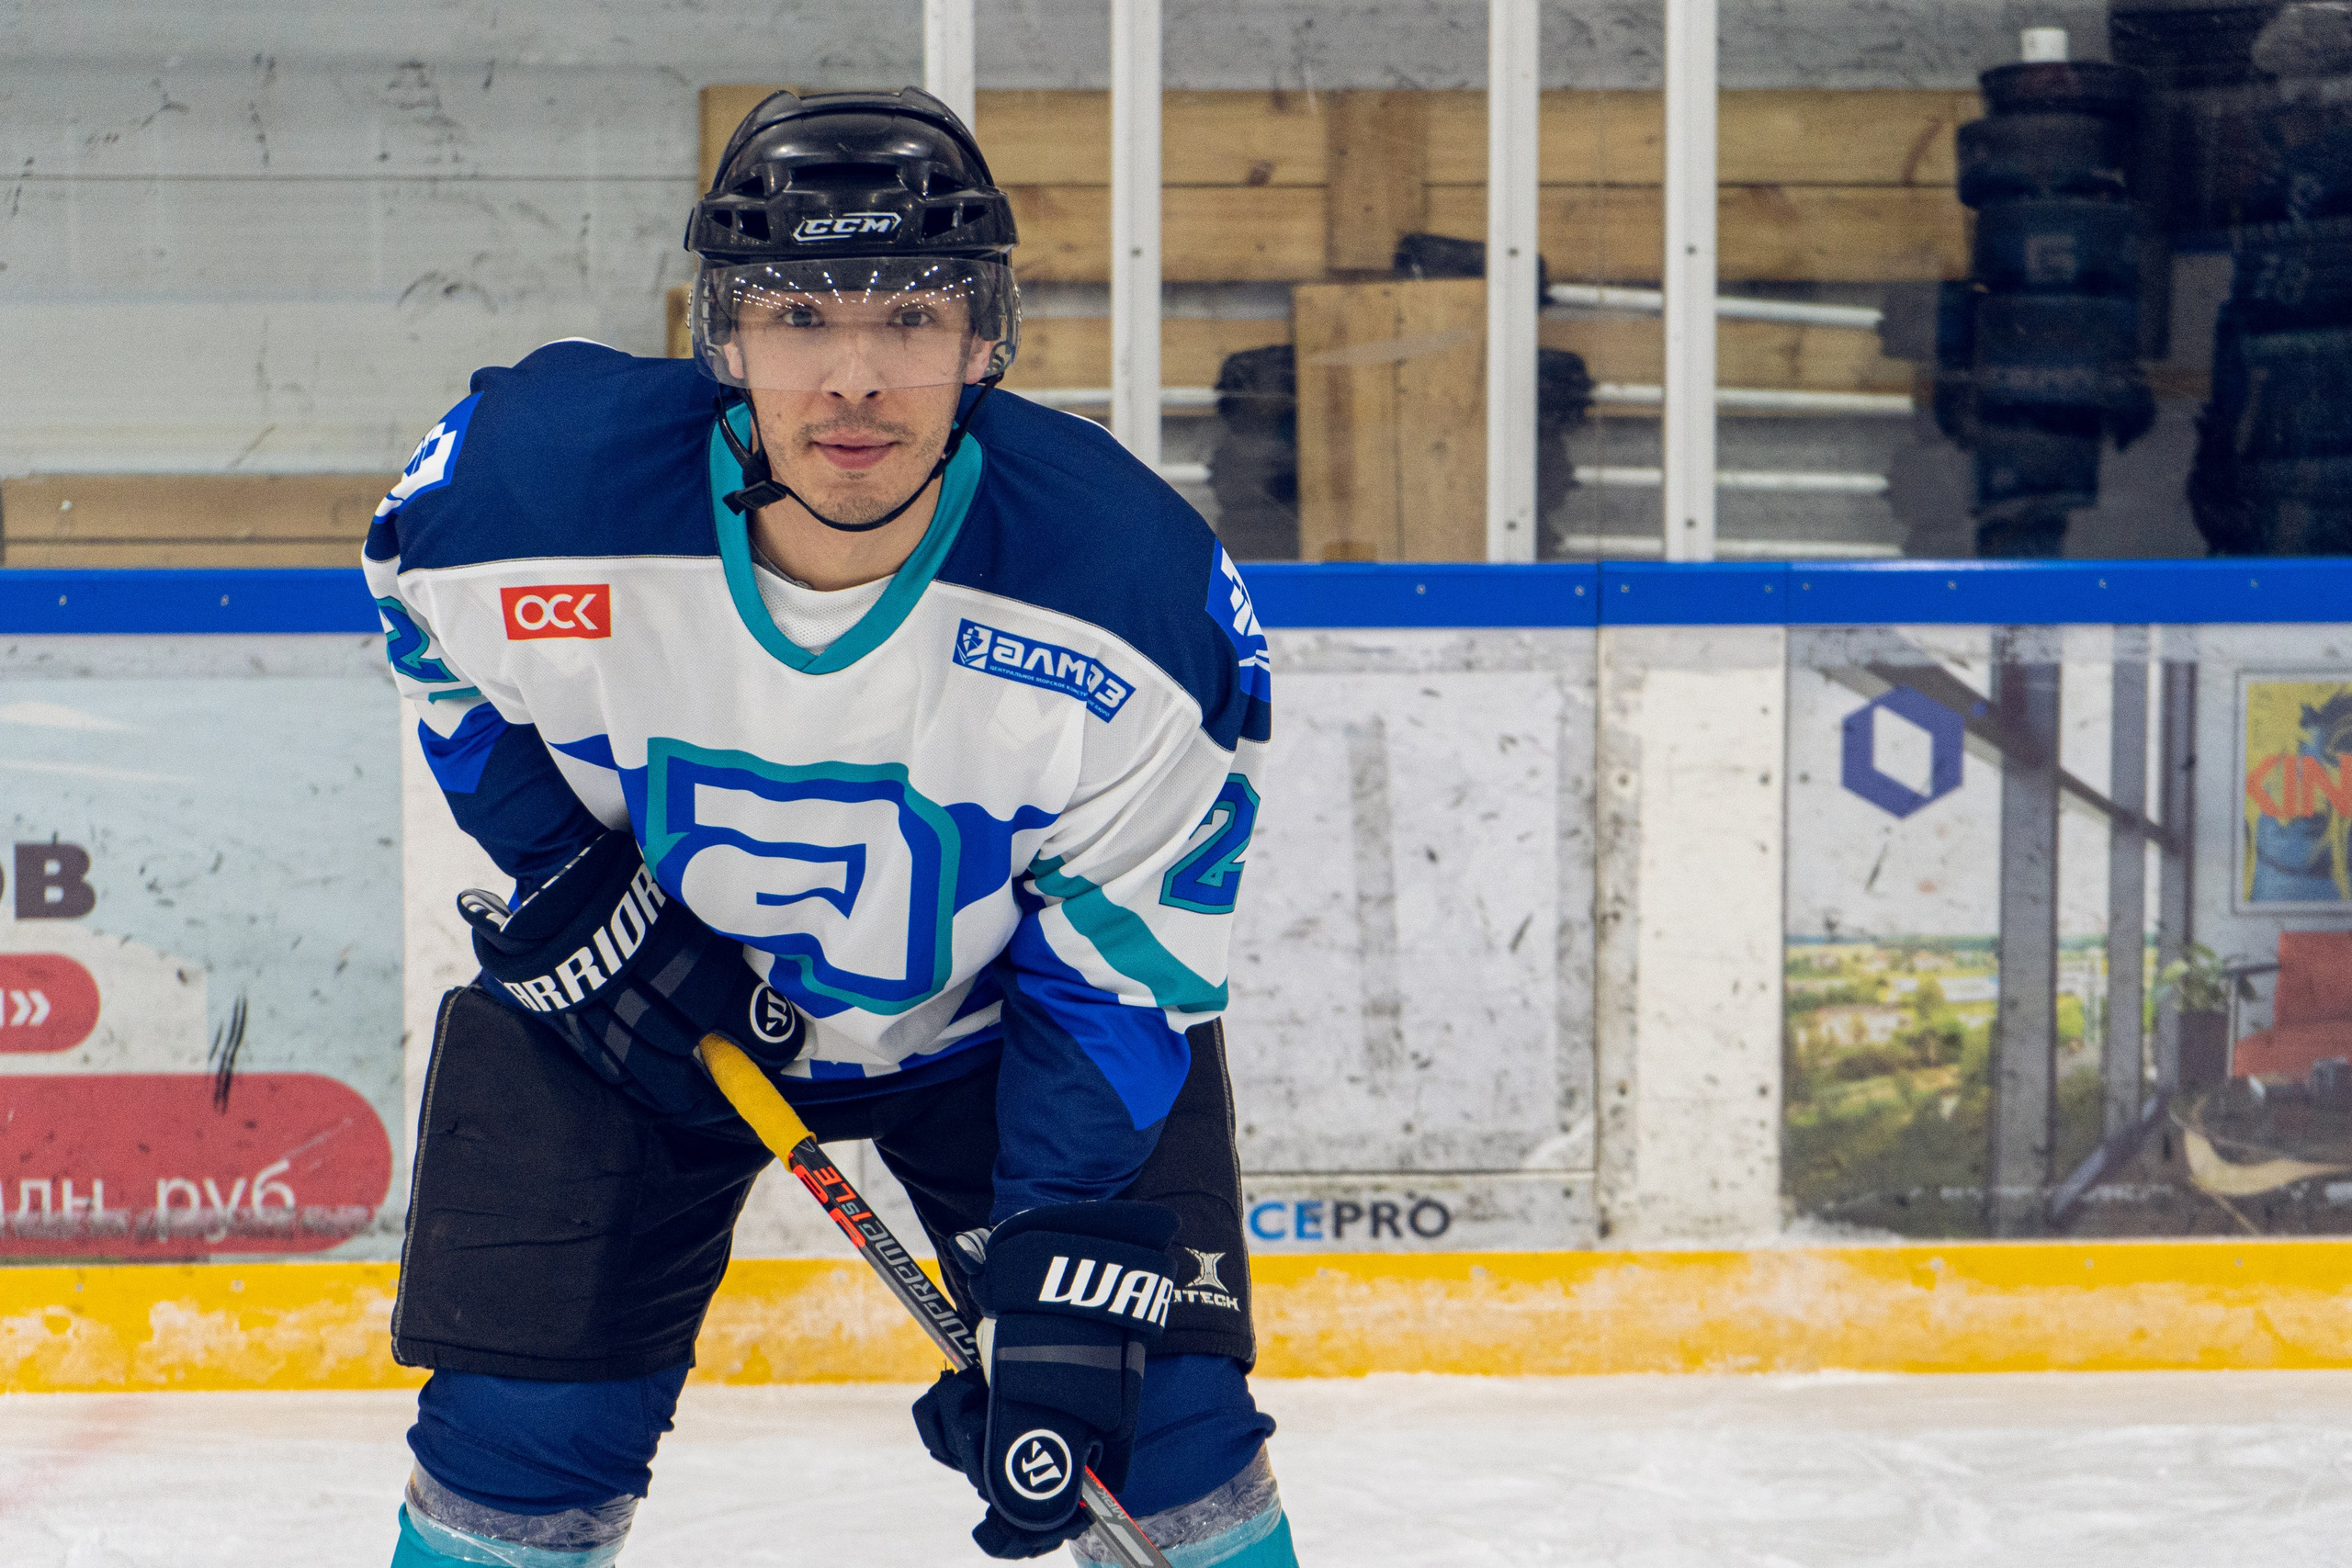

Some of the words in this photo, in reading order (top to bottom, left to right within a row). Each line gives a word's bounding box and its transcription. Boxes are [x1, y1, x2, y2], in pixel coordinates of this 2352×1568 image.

[804, 218, 891, 235] CCM
[989, 664, 1035, 682] ЦЕНТРАЛЬНОЕ
[1035, 676, 1066, 690] МОРСКОЕ
[0, 842, 96, 919] В
[1159, 773, 1261, 915] 2
[502, 862, 667, 1011] ARRIOR
